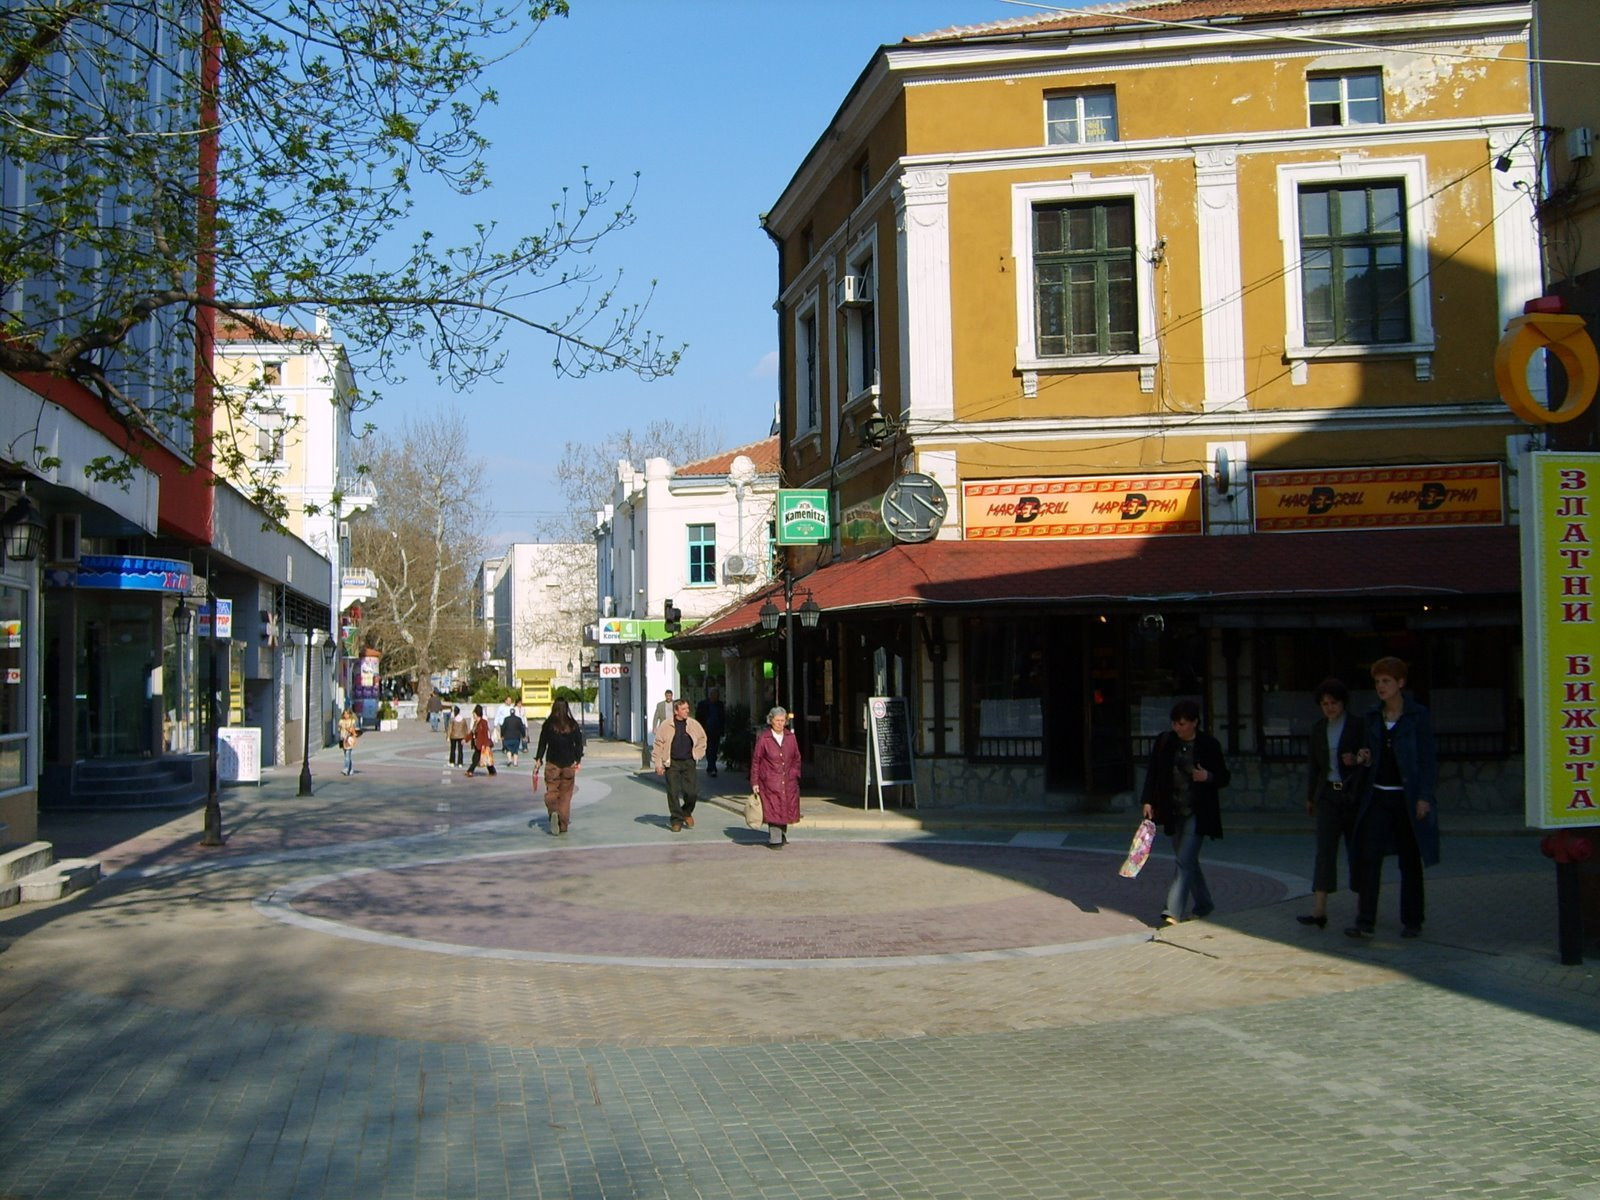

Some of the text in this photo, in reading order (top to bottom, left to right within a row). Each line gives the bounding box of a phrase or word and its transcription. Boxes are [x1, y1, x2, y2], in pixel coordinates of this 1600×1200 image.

[785, 509, 825, 523] Kamenitza
[1556, 470, 1598, 809] ЗЛАТНИ БИЖУТА
[602, 666, 629, 675] ФОТО
